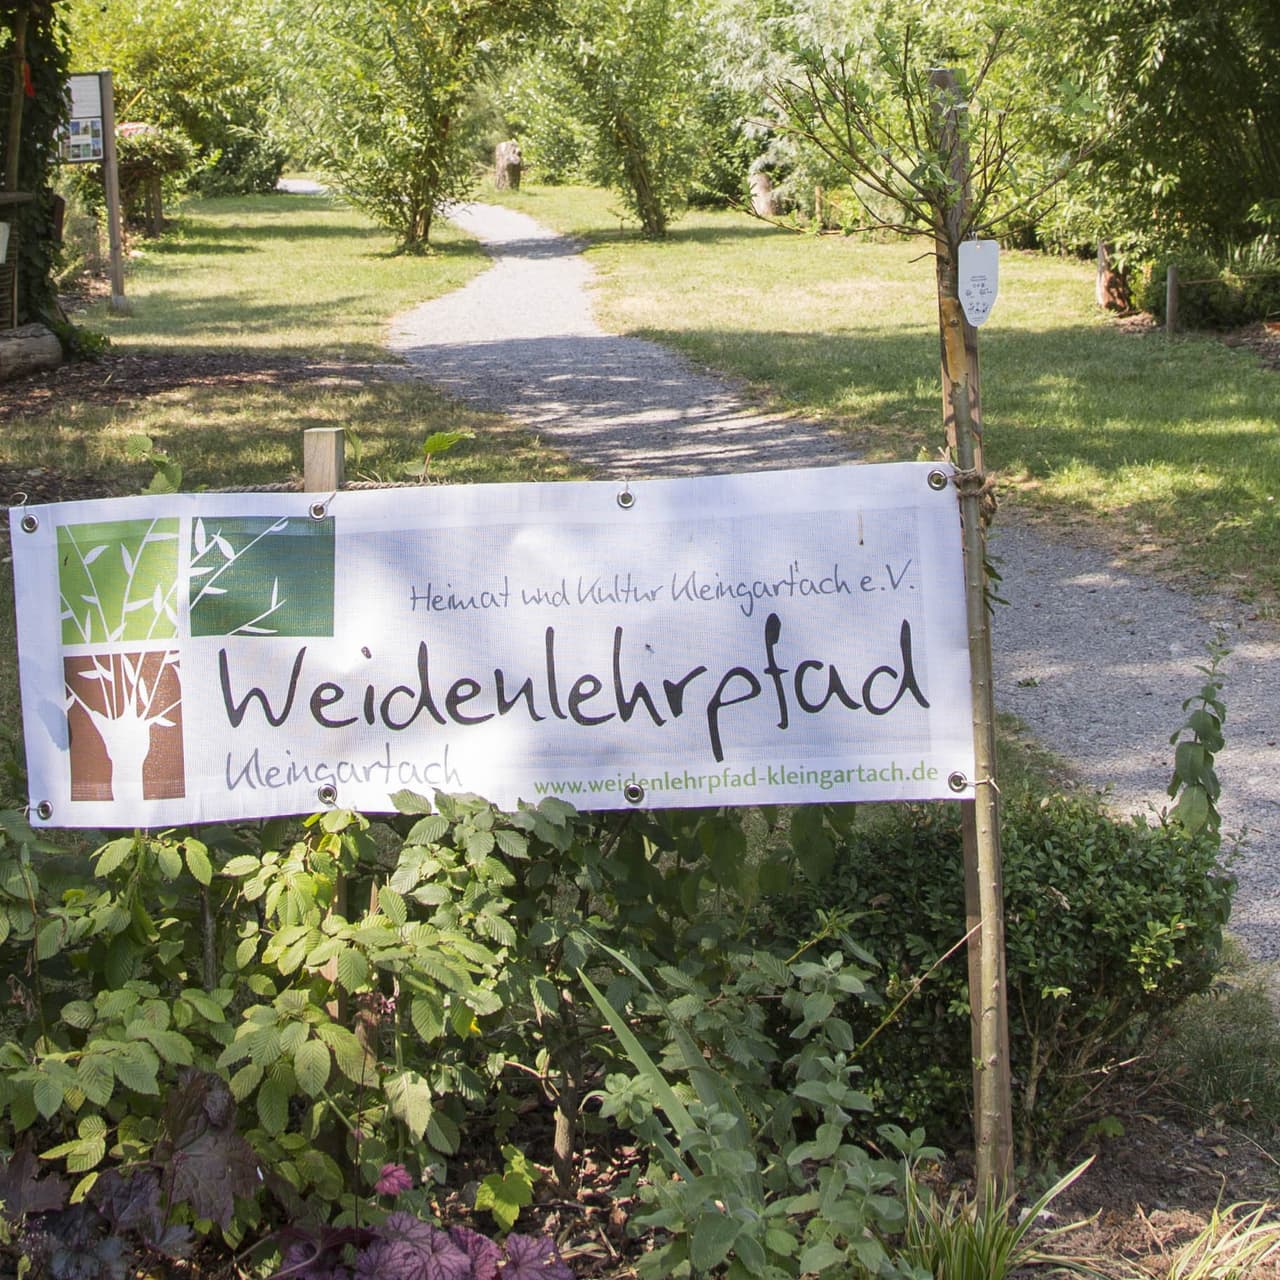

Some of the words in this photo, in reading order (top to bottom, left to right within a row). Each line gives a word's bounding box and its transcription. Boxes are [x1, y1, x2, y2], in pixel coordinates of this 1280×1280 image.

[410, 575, 512, 612] Heimat
[521, 578, 571, 608] und
[577, 572, 664, 606] Kultur
[671, 562, 852, 618] Kleingartach
[859, 558, 916, 594] e.V.
[218, 612, 931, 763] Weidenlehrpfad
[225, 741, 464, 792] Kleingartach
[533, 759, 939, 795] www.weidenlehrpfad-kleingartach.de
